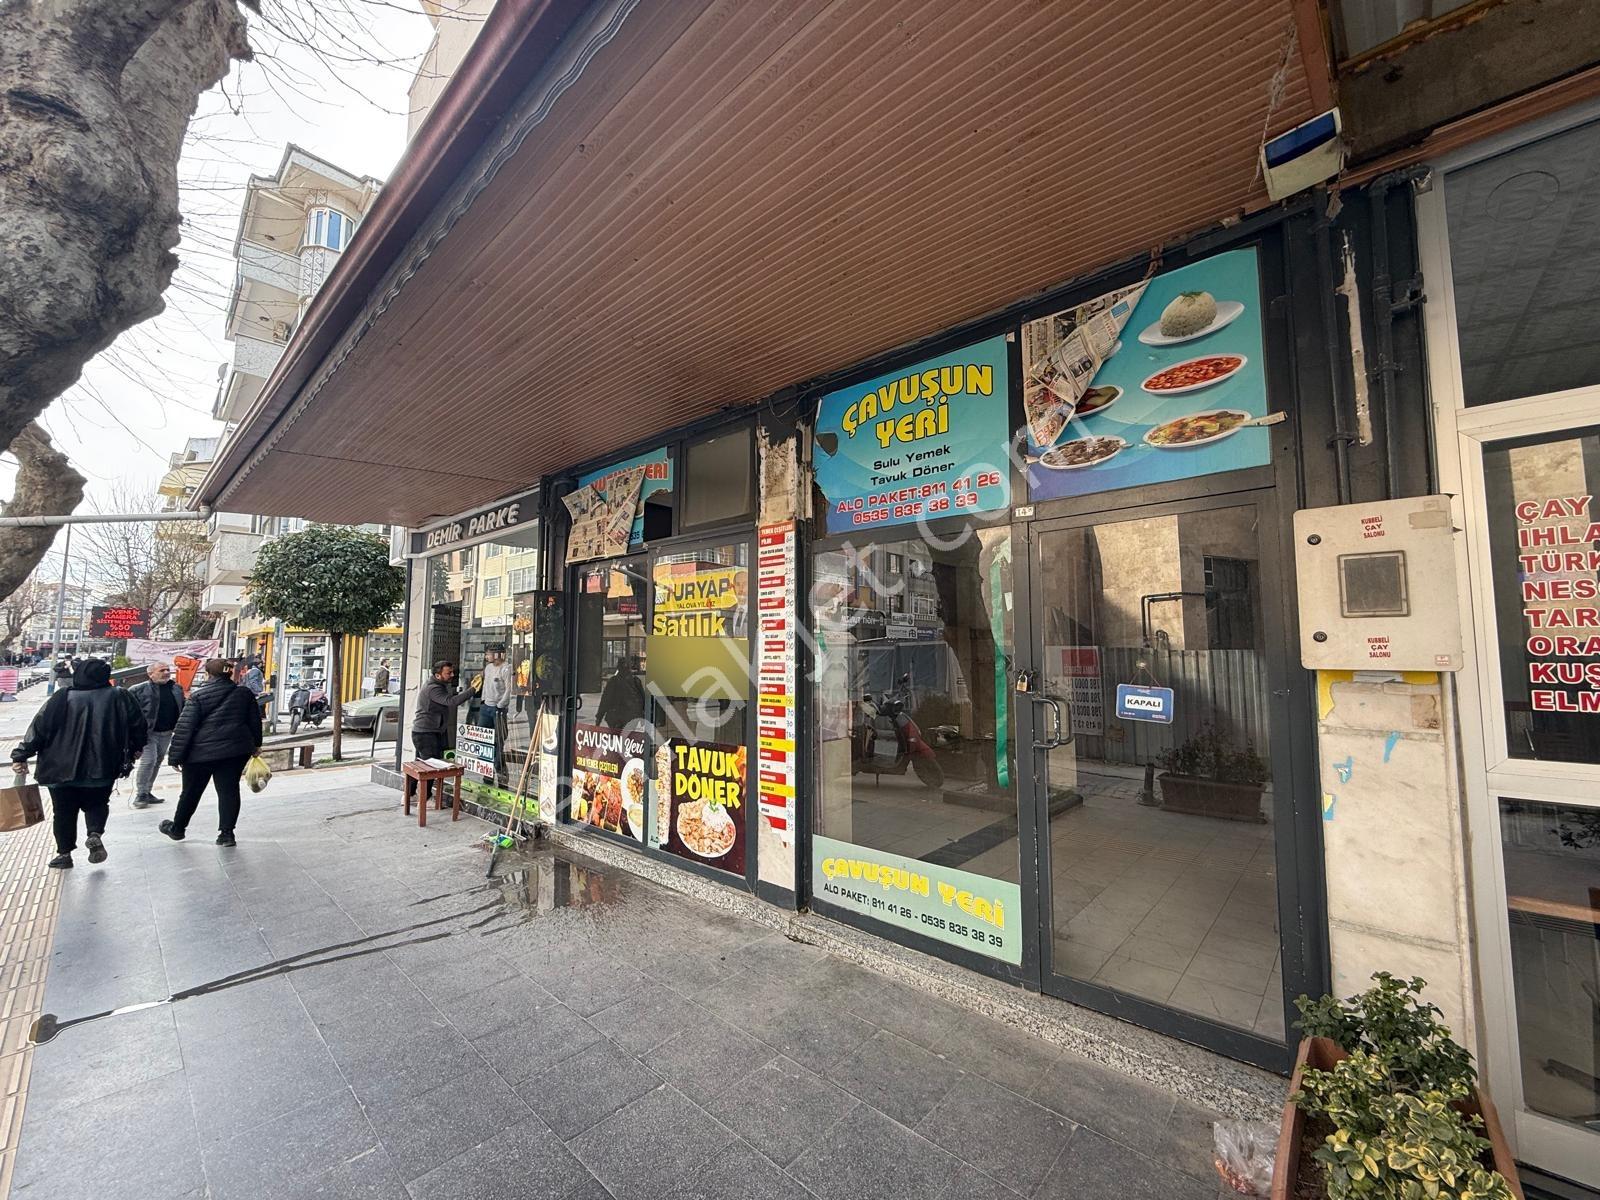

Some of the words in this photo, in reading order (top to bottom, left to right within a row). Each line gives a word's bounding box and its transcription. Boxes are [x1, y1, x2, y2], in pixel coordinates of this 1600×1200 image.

[842, 365, 993, 439] ÇAVUŞUN
[876, 396, 949, 449] YERİ
[645, 462, 669, 480] ERİ
[874, 457, 900, 470] Sulu
[906, 445, 951, 463] Yemek
[871, 472, 907, 486] Tavuk
[913, 462, 955, 478] Döner
[837, 498, 864, 513] ALO
[952, 478, 970, 491] 41
[977, 472, 1000, 488] 26
[853, 507, 888, 524] 0535
[895, 502, 923, 518] 835
[929, 498, 949, 513] 38
[955, 492, 978, 507] 39
[1515, 496, 1593, 525] ÇAY
[426, 521, 463, 548] DEMİR
[468, 503, 520, 536] PARKE
[1365, 524, 1382, 532] ÇAY
[1523, 578, 1600, 602] NES
[654, 612, 726, 637] Satılık
[1127, 699, 1161, 708] KAPALI
[466, 725, 493, 735] ÇAMSAN
[576, 730, 623, 755] ÇAVUŞUN
[624, 738, 644, 758] Yeri
[464, 758, 475, 770] AGT
[476, 760, 493, 777] Parke
[676, 745, 740, 779] TAVUK
[676, 772, 741, 810] DÖNER
[821, 857, 930, 898] ÇAVUŞUN
[938, 880, 1005, 930] YERİ
[824, 883, 838, 894] ALO
[841, 888, 870, 905] PAKET:
[872, 898, 885, 909] 811
[888, 904, 897, 913] 41
[900, 907, 911, 918] 26
[921, 914, 946, 929] 0535
[949, 923, 968, 937] 835
[972, 929, 985, 942] 38
[989, 934, 1003, 948] 39
